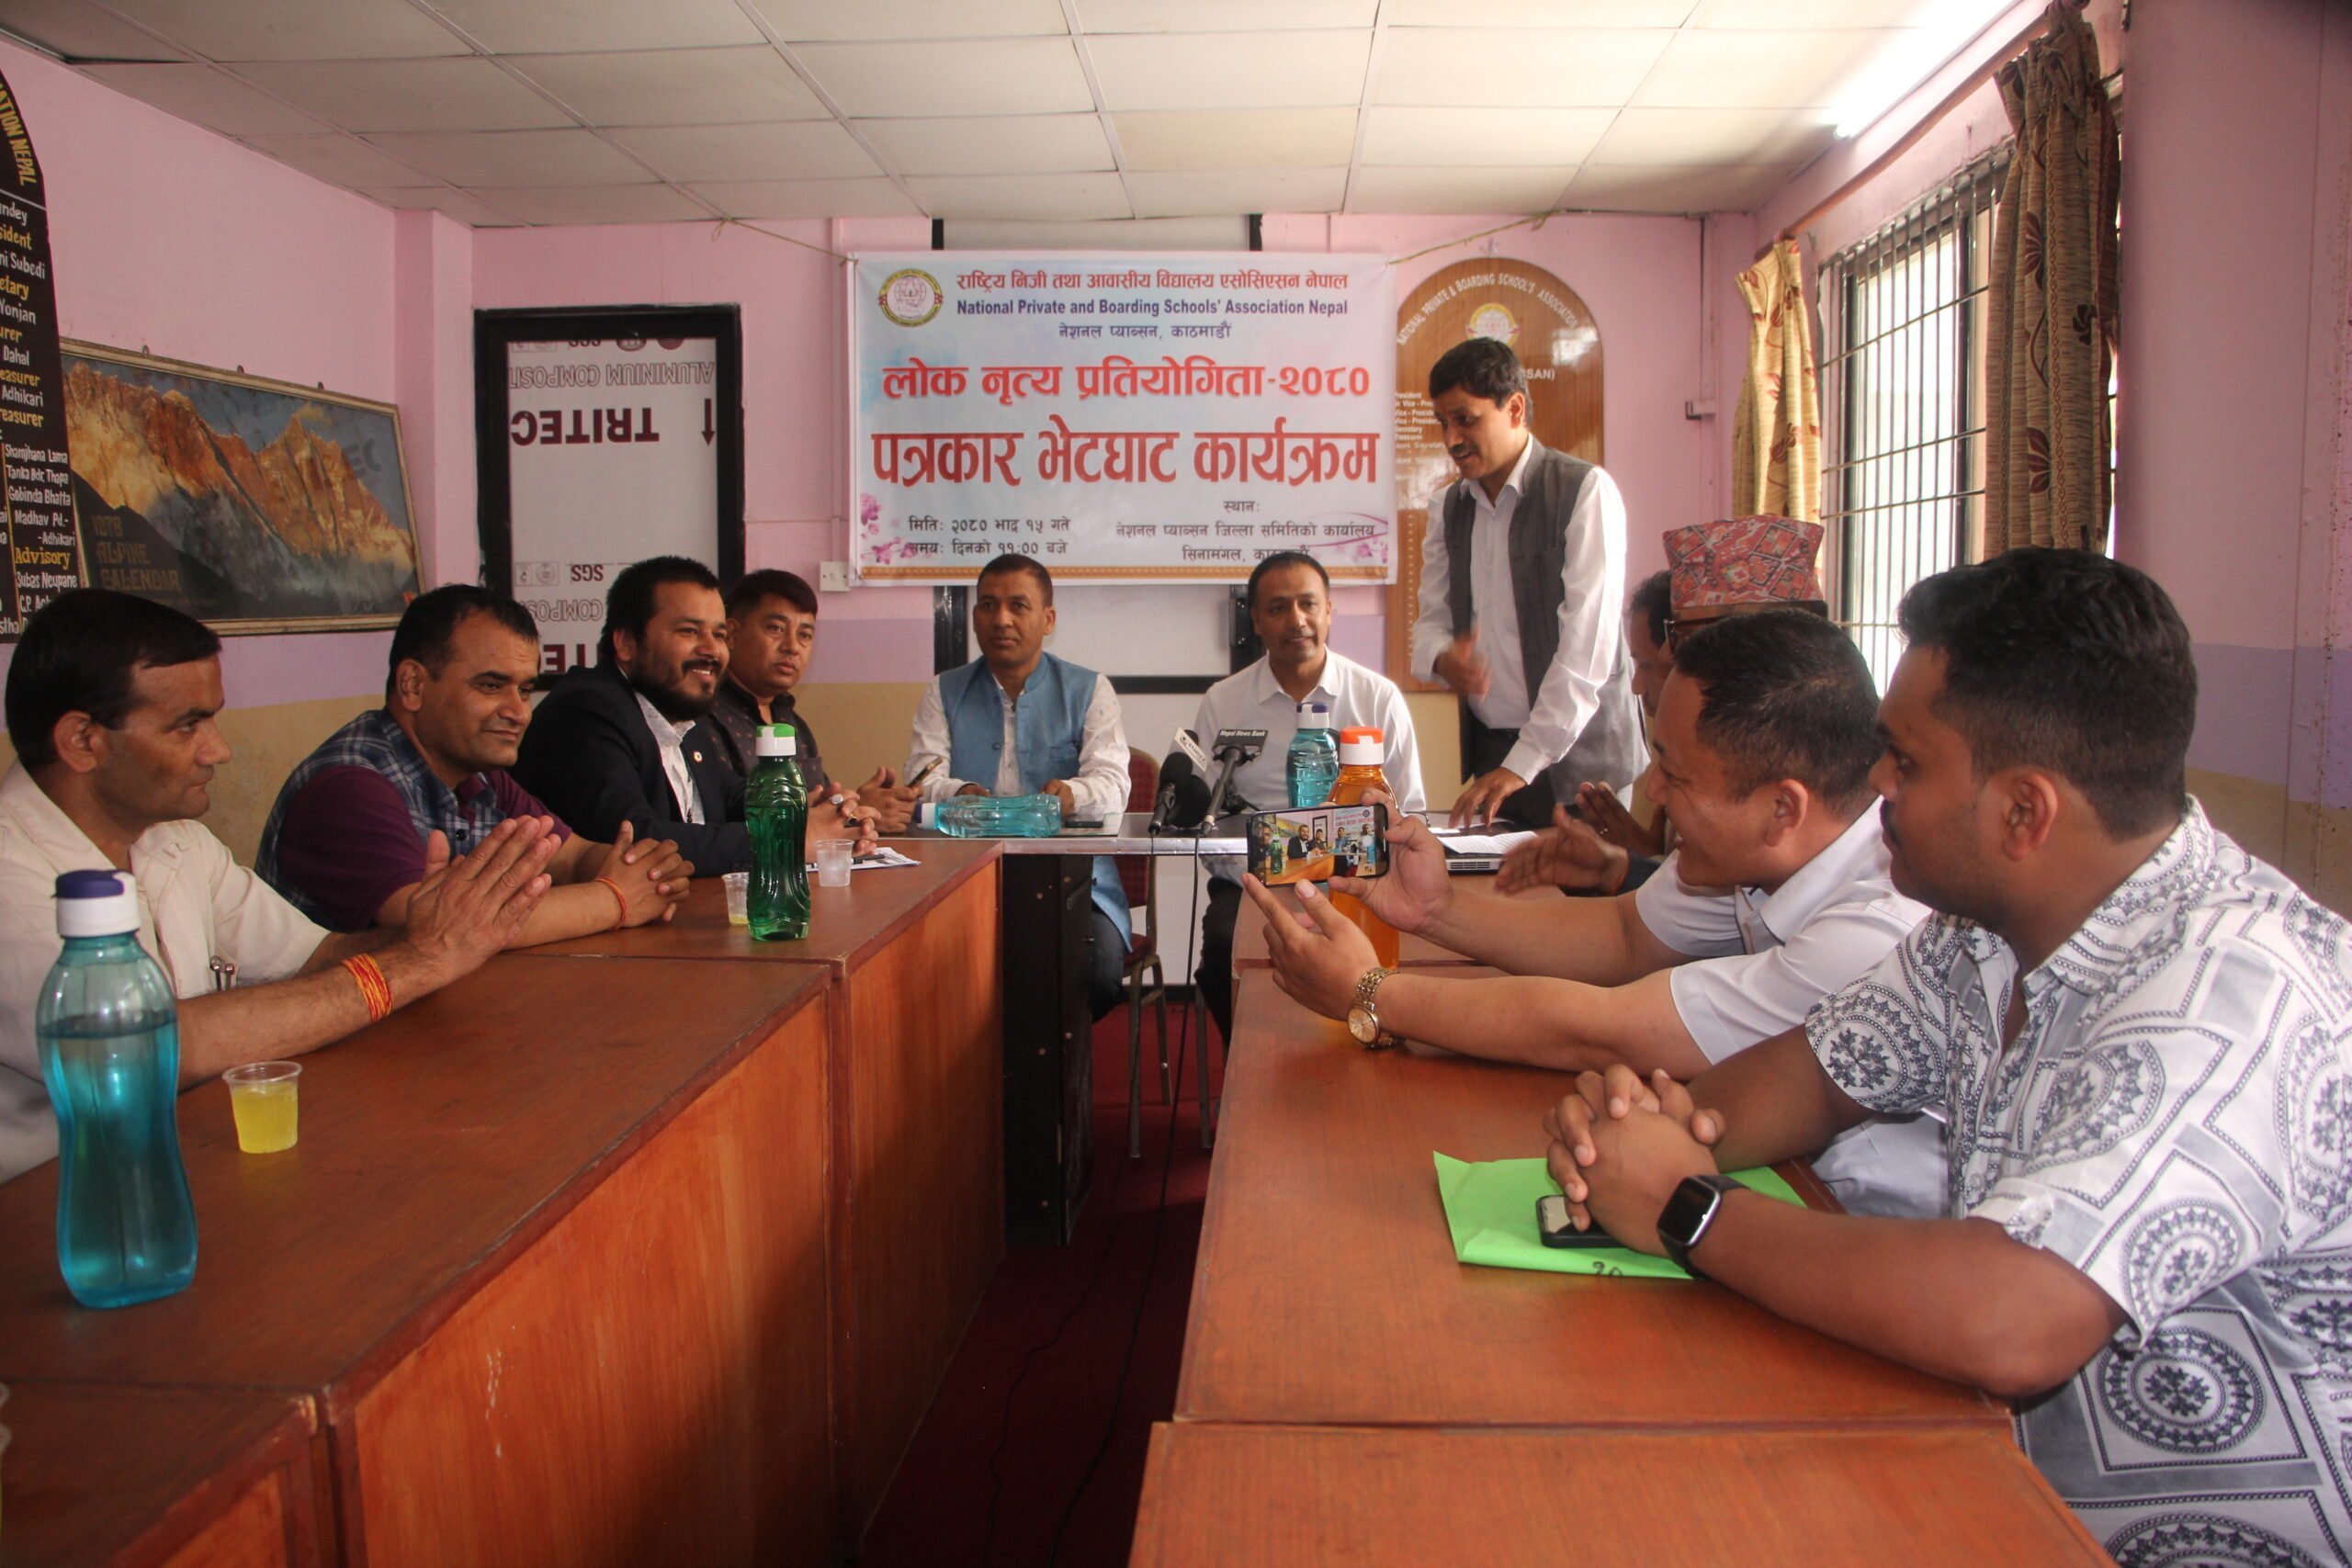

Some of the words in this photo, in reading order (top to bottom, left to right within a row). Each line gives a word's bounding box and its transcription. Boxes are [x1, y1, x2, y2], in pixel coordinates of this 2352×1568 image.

[9, 138, 37, 186] NEPAL
[10, 252, 45, 279] Subedi
[1011, 270, 1047, 288] निजी
[1052, 273, 1081, 288] तथा
[1087, 270, 1150, 289] आवासीय
[1156, 269, 1215, 289] विद्यालय
[1219, 269, 1300, 289] एसोसिएसन
[1305, 270, 1349, 289] नेपाल
[957, 299, 1013, 315] National
[1018, 299, 1065, 315] Private
[1069, 299, 1094, 314] and
[1099, 299, 1159, 318] Boarding
[1163, 299, 1221, 314] Schools'
[1225, 299, 1305, 314] Association
[1308, 299, 1348, 318] Nepal
[1422, 288, 1450, 317] PRIVATE
[1455, 273, 1495, 292] BOARDING
[1498, 273, 1535, 294] SCHOOL'S
[1537, 289, 1579, 328] ASSOCIATION
[1059, 322, 1102, 339] नेशनल
[1171, 321, 1232, 339] काठमाडौं
[4, 344, 29, 367] Dahal
[605, 361, 715, 386] ALUMINIUM
[882, 357, 969, 400] लोक
[981, 366, 1063, 406] नृत्य
[1521, 368, 1555, 381] SAN)
[2, 384, 43, 408] Adhikari
[511, 407, 660, 446] TRITEC
[48, 449, 68, 465] Lama
[871, 432, 1024, 488] पत्रकार
[1038, 413, 1180, 483] भेटघाट
[1193, 416, 1381, 487] कार्यक्रम
[6, 465, 29, 479] Tanka
[47, 469, 69, 488] Thapa
[8, 485, 43, 503] Gobinda
[44, 489, 71, 507] Bhatta
[15, 510, 49, 527] Madhav
[1050, 515, 1071, 532] गते
[1116, 521, 1157, 537] नेशनल
[1216, 521, 1254, 537] जिल्ला
[1261, 521, 1317, 537] समितिको
[1323, 521, 1375, 537] कार्यालय
[15, 547, 72, 570] Advisory
[96, 541, 152, 564] ALPINE
[952, 538, 991, 557] दिनको
[1046, 538, 1069, 555] बजे
[17, 571, 40, 589] Subas
[42, 572, 77, 592] Neupane
[100, 568, 182, 592] CALENDAR
[571, 564, 604, 582] SGS
[524, 599, 604, 623] COMPOS
